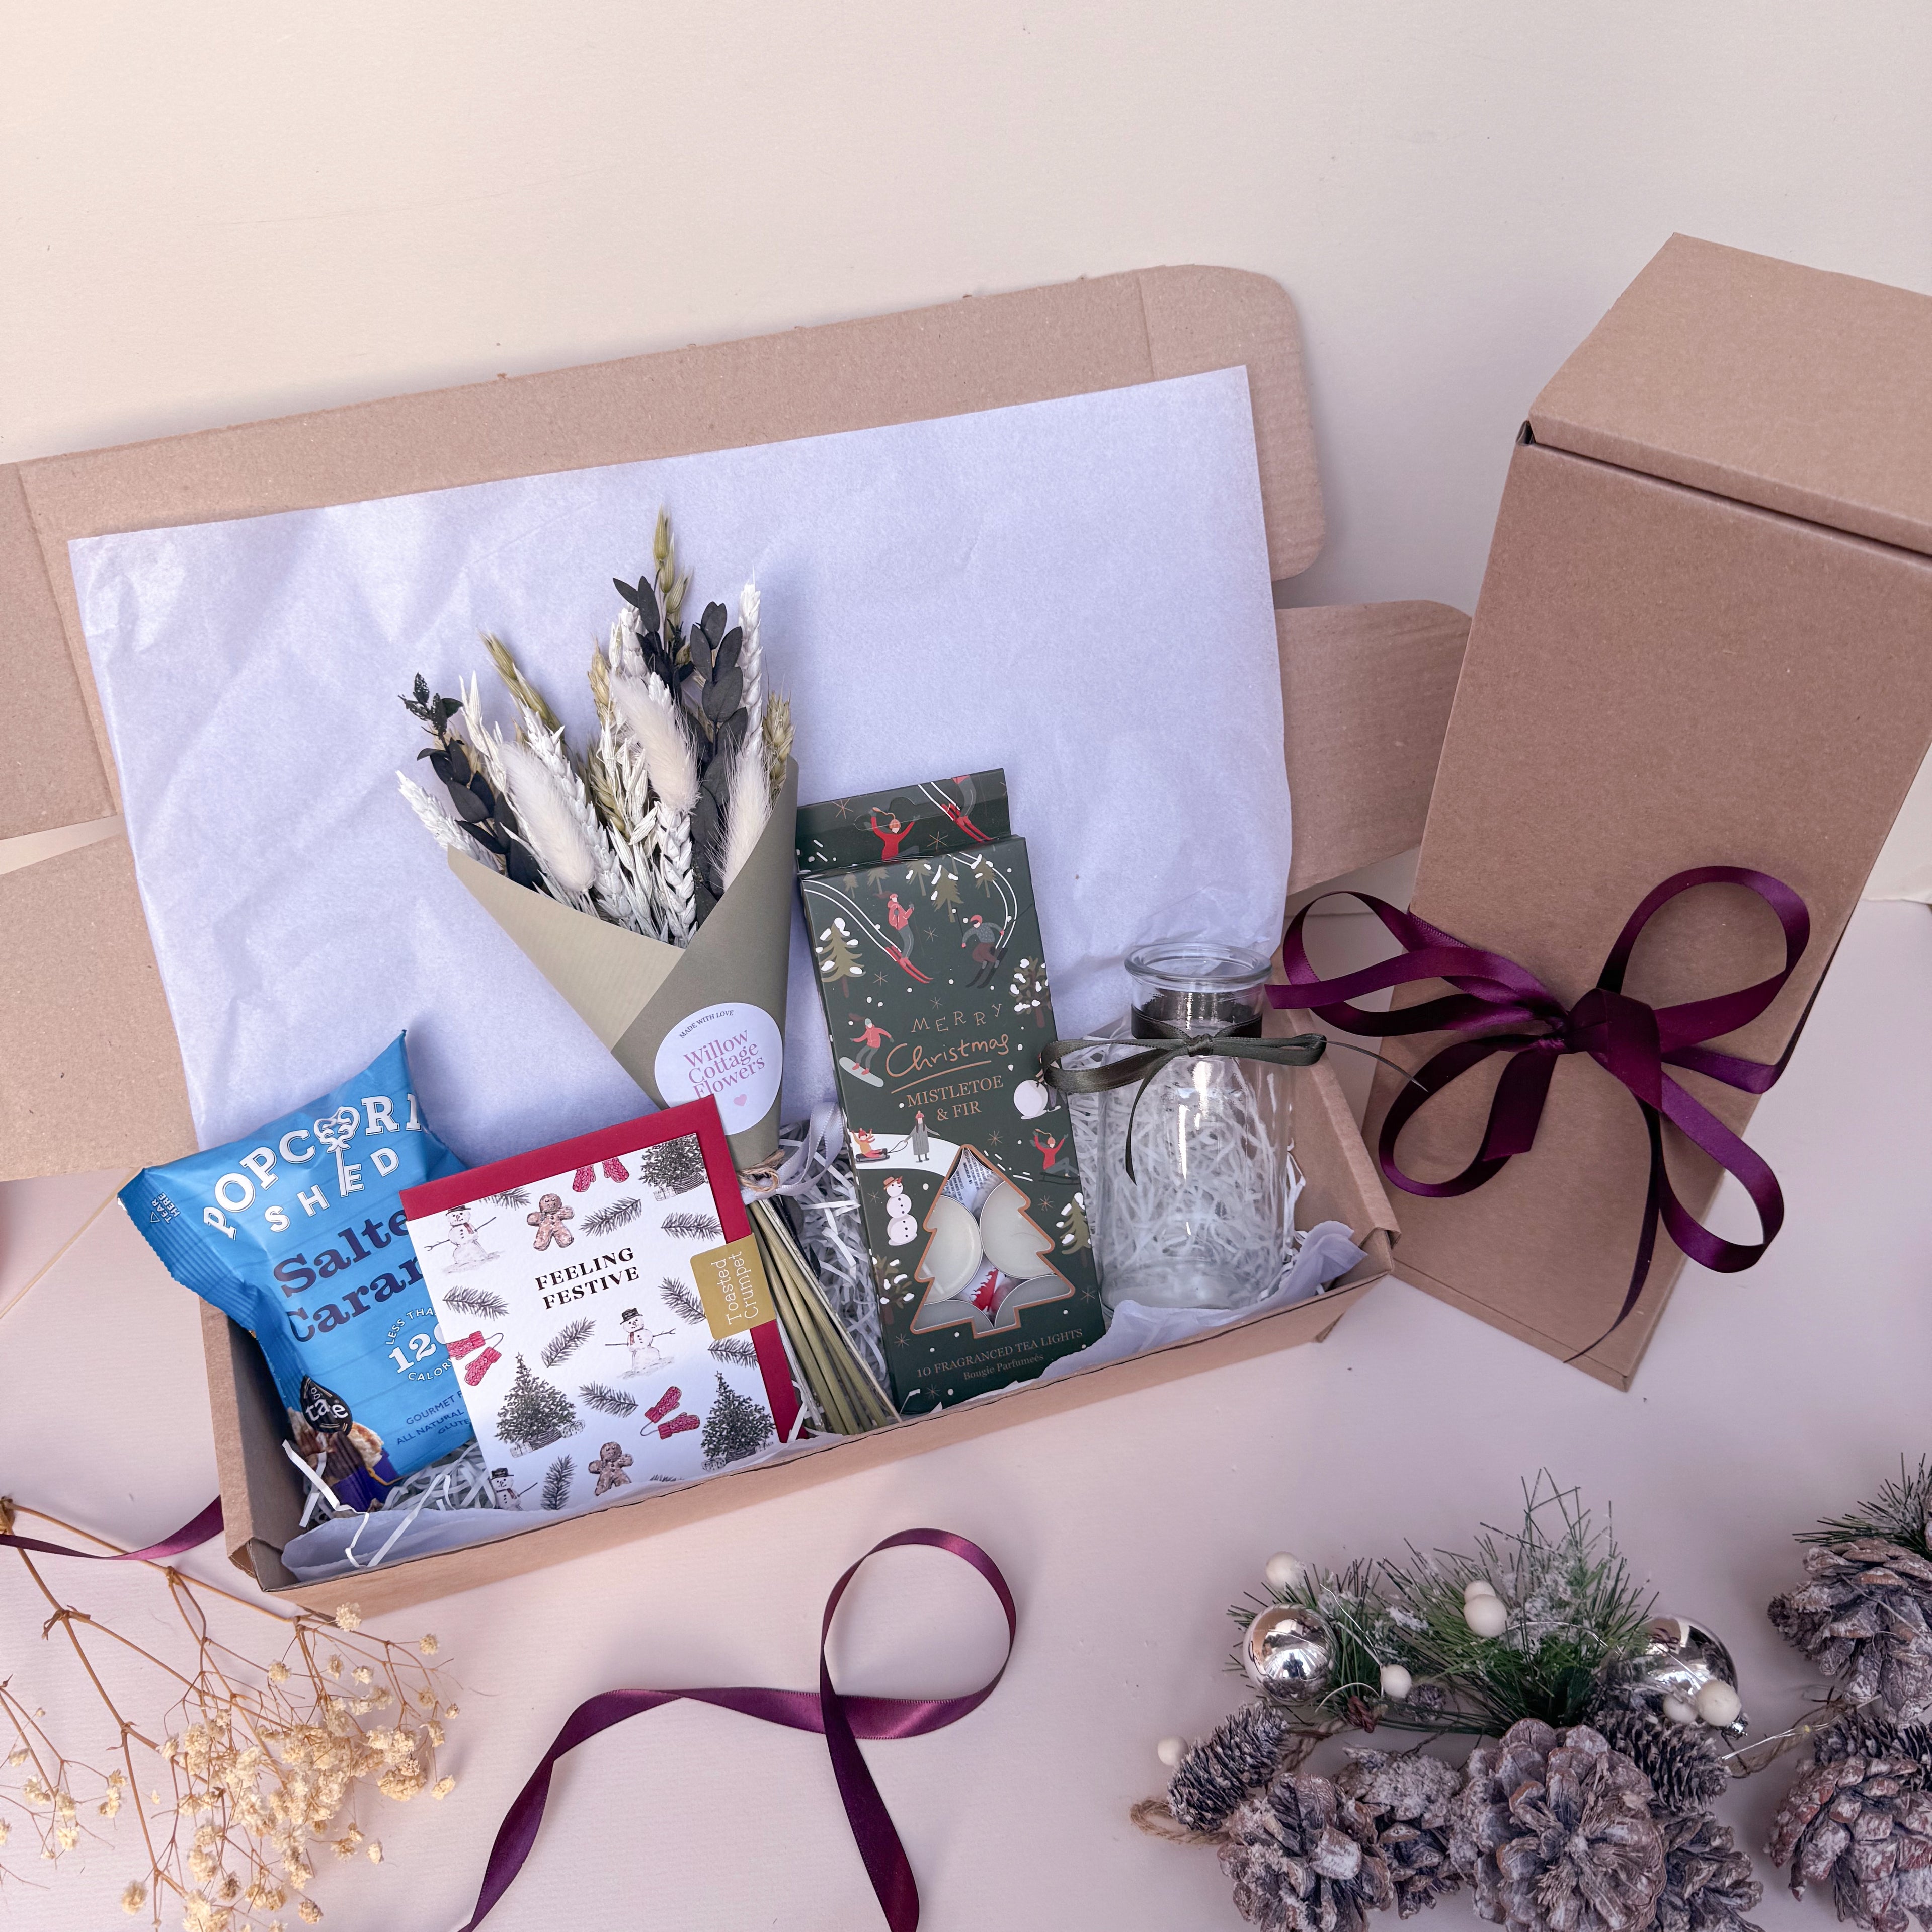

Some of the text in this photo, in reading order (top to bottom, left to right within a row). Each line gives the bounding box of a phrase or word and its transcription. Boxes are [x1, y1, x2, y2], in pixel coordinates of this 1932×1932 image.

[679, 1010, 734, 1038] MADE WITH LOVE
[911, 1003, 1002, 1033] MERRY
[683, 1030, 748, 1067] Willow
[688, 1043, 759, 1084] Cottage
[886, 1034, 1009, 1078] Christmas
[692, 1057, 765, 1099] Flowers
[906, 1075, 1004, 1108] MISTLETOE
[936, 1101, 982, 1121] & FIR
[158, 1192, 180, 1217] HERE
[264, 1147, 399, 1233] SHED
[151, 1198, 171, 1223] TEAR
[535, 1247, 634, 1291] FEELING
[542, 1266, 639, 1309] FESTIVE
[728, 1251, 759, 1319] Crumpet
[711, 1258, 742, 1325] Toasted
[385, 1307, 436, 1345] LESS THA
[917, 1328, 1083, 1378] 10 FRAGRANCED TEA LIGHTS
[963, 1365, 995, 1380] Bougie
[397, 1409, 465, 1445] ALL NATURAL
[406, 1394, 455, 1425] GOURMET
